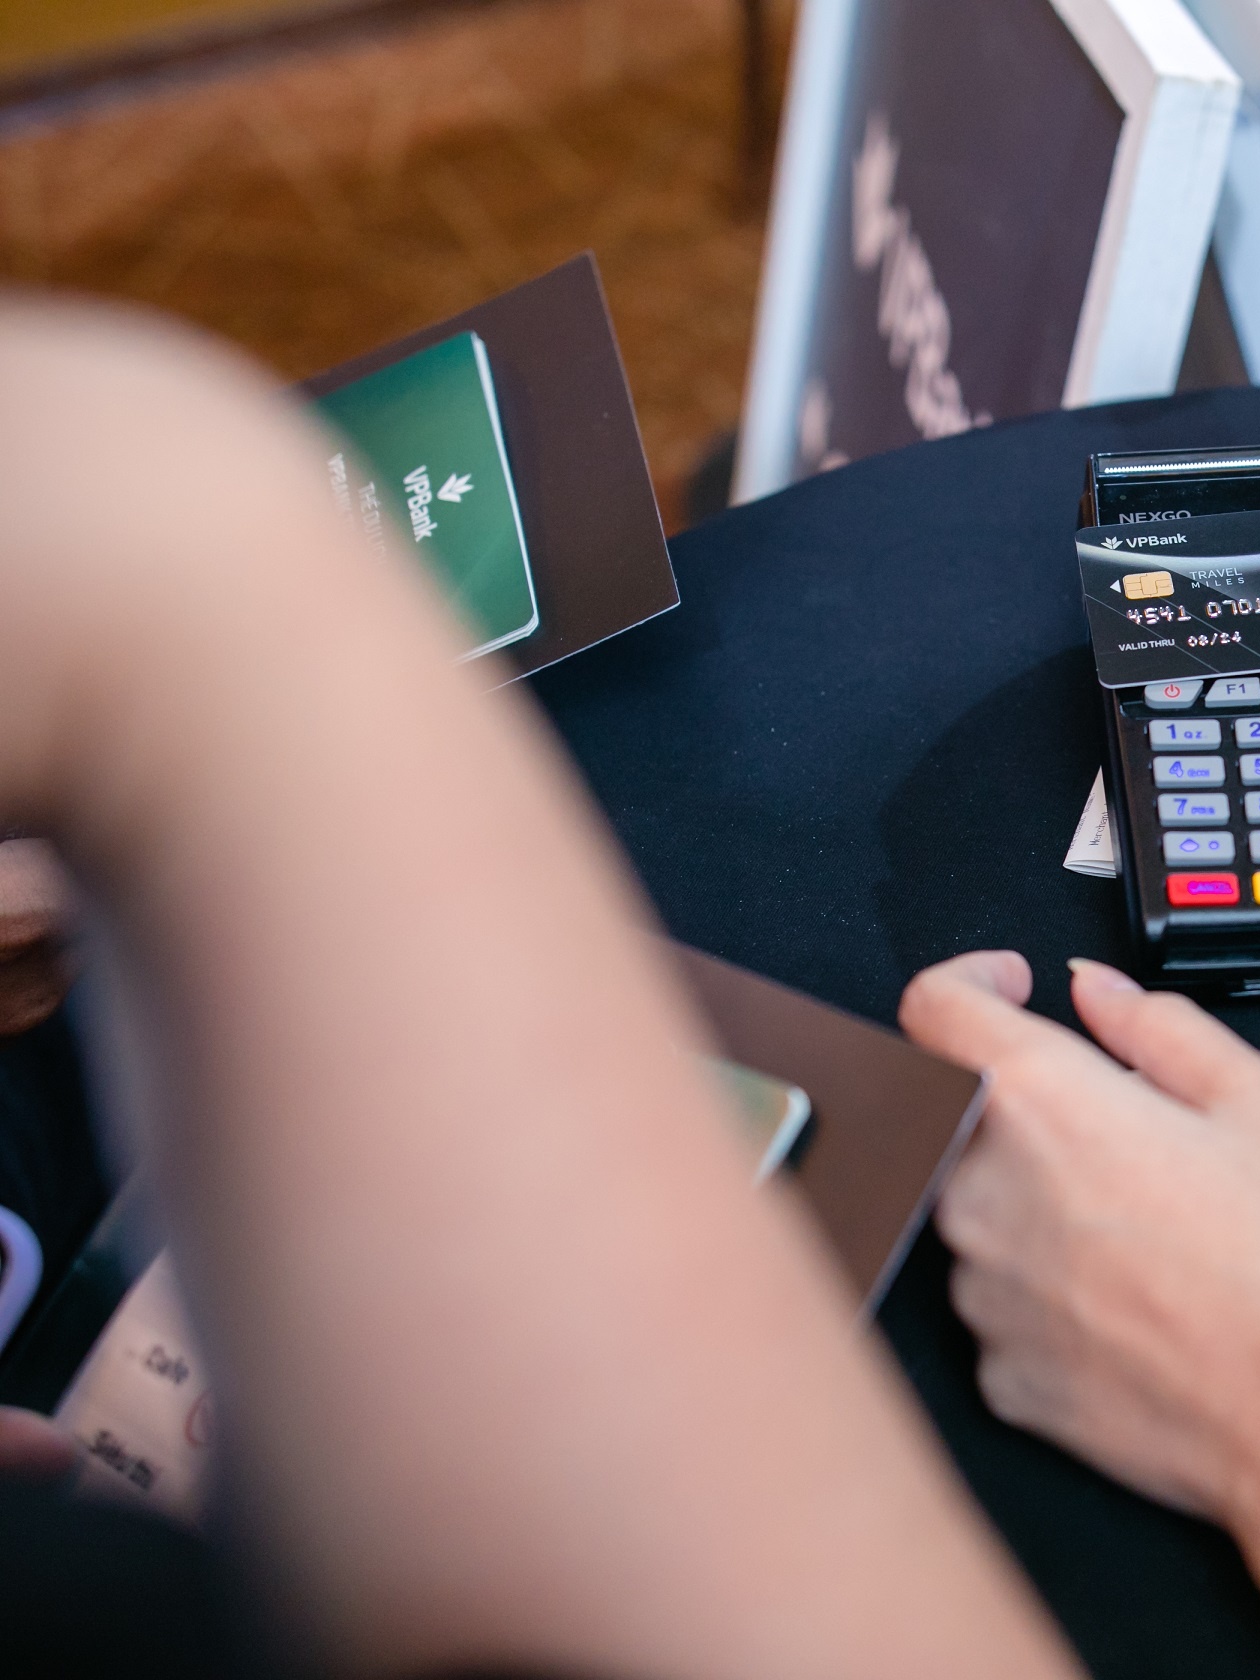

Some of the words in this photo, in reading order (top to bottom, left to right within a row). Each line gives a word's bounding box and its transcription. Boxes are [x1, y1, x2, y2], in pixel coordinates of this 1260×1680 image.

[403, 465, 438, 543] VPBank
[1119, 510, 1191, 524] NEXGO
[1126, 533, 1188, 548] VPBank
[1190, 568, 1242, 579] TRAVEL
[1191, 577, 1245, 589] MILES
[1127, 605, 1191, 625] 4541
[1119, 641, 1148, 652] VALID
[1150, 639, 1175, 648] THRU
[1187, 631, 1242, 647] 08/24
[1226, 683, 1246, 695] F1
[1166, 724, 1177, 740] 1
[1169, 761, 1184, 777] 4
[1174, 798, 1188, 815] 7
